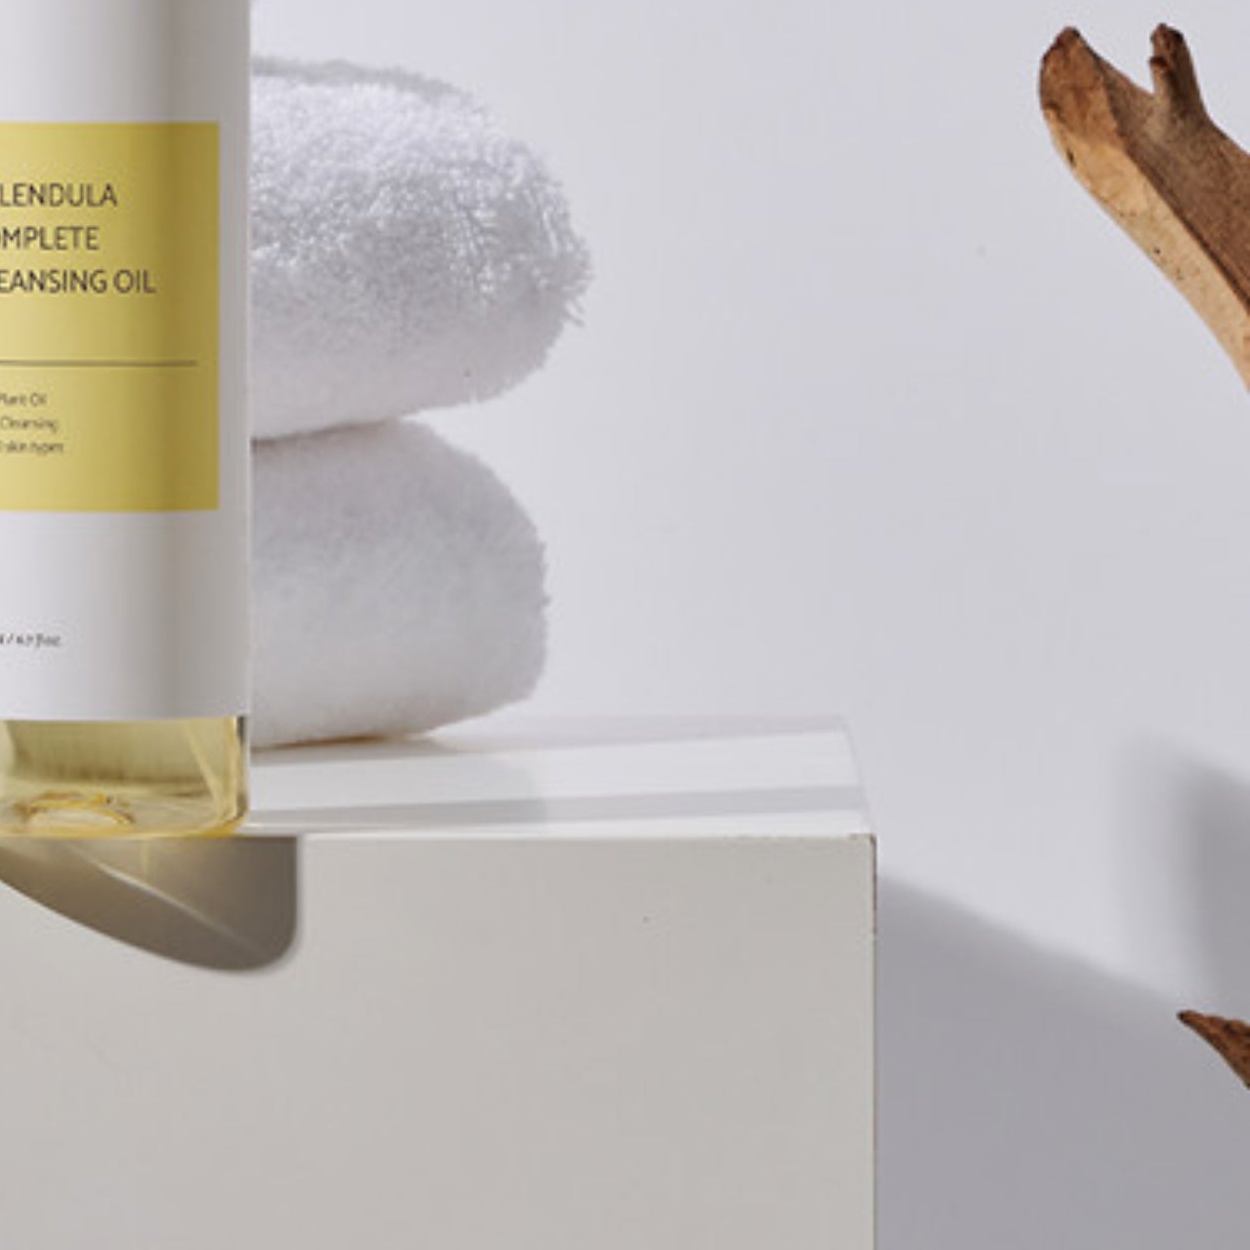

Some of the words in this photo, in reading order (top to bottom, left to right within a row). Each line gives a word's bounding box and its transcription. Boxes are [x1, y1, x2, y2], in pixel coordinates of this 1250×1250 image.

[113, 268, 157, 295] OIL
[29, 393, 47, 406] Oil
[0, 414, 59, 434] Cleansing
[4, 439, 28, 453] skin
[30, 440, 64, 456] types
